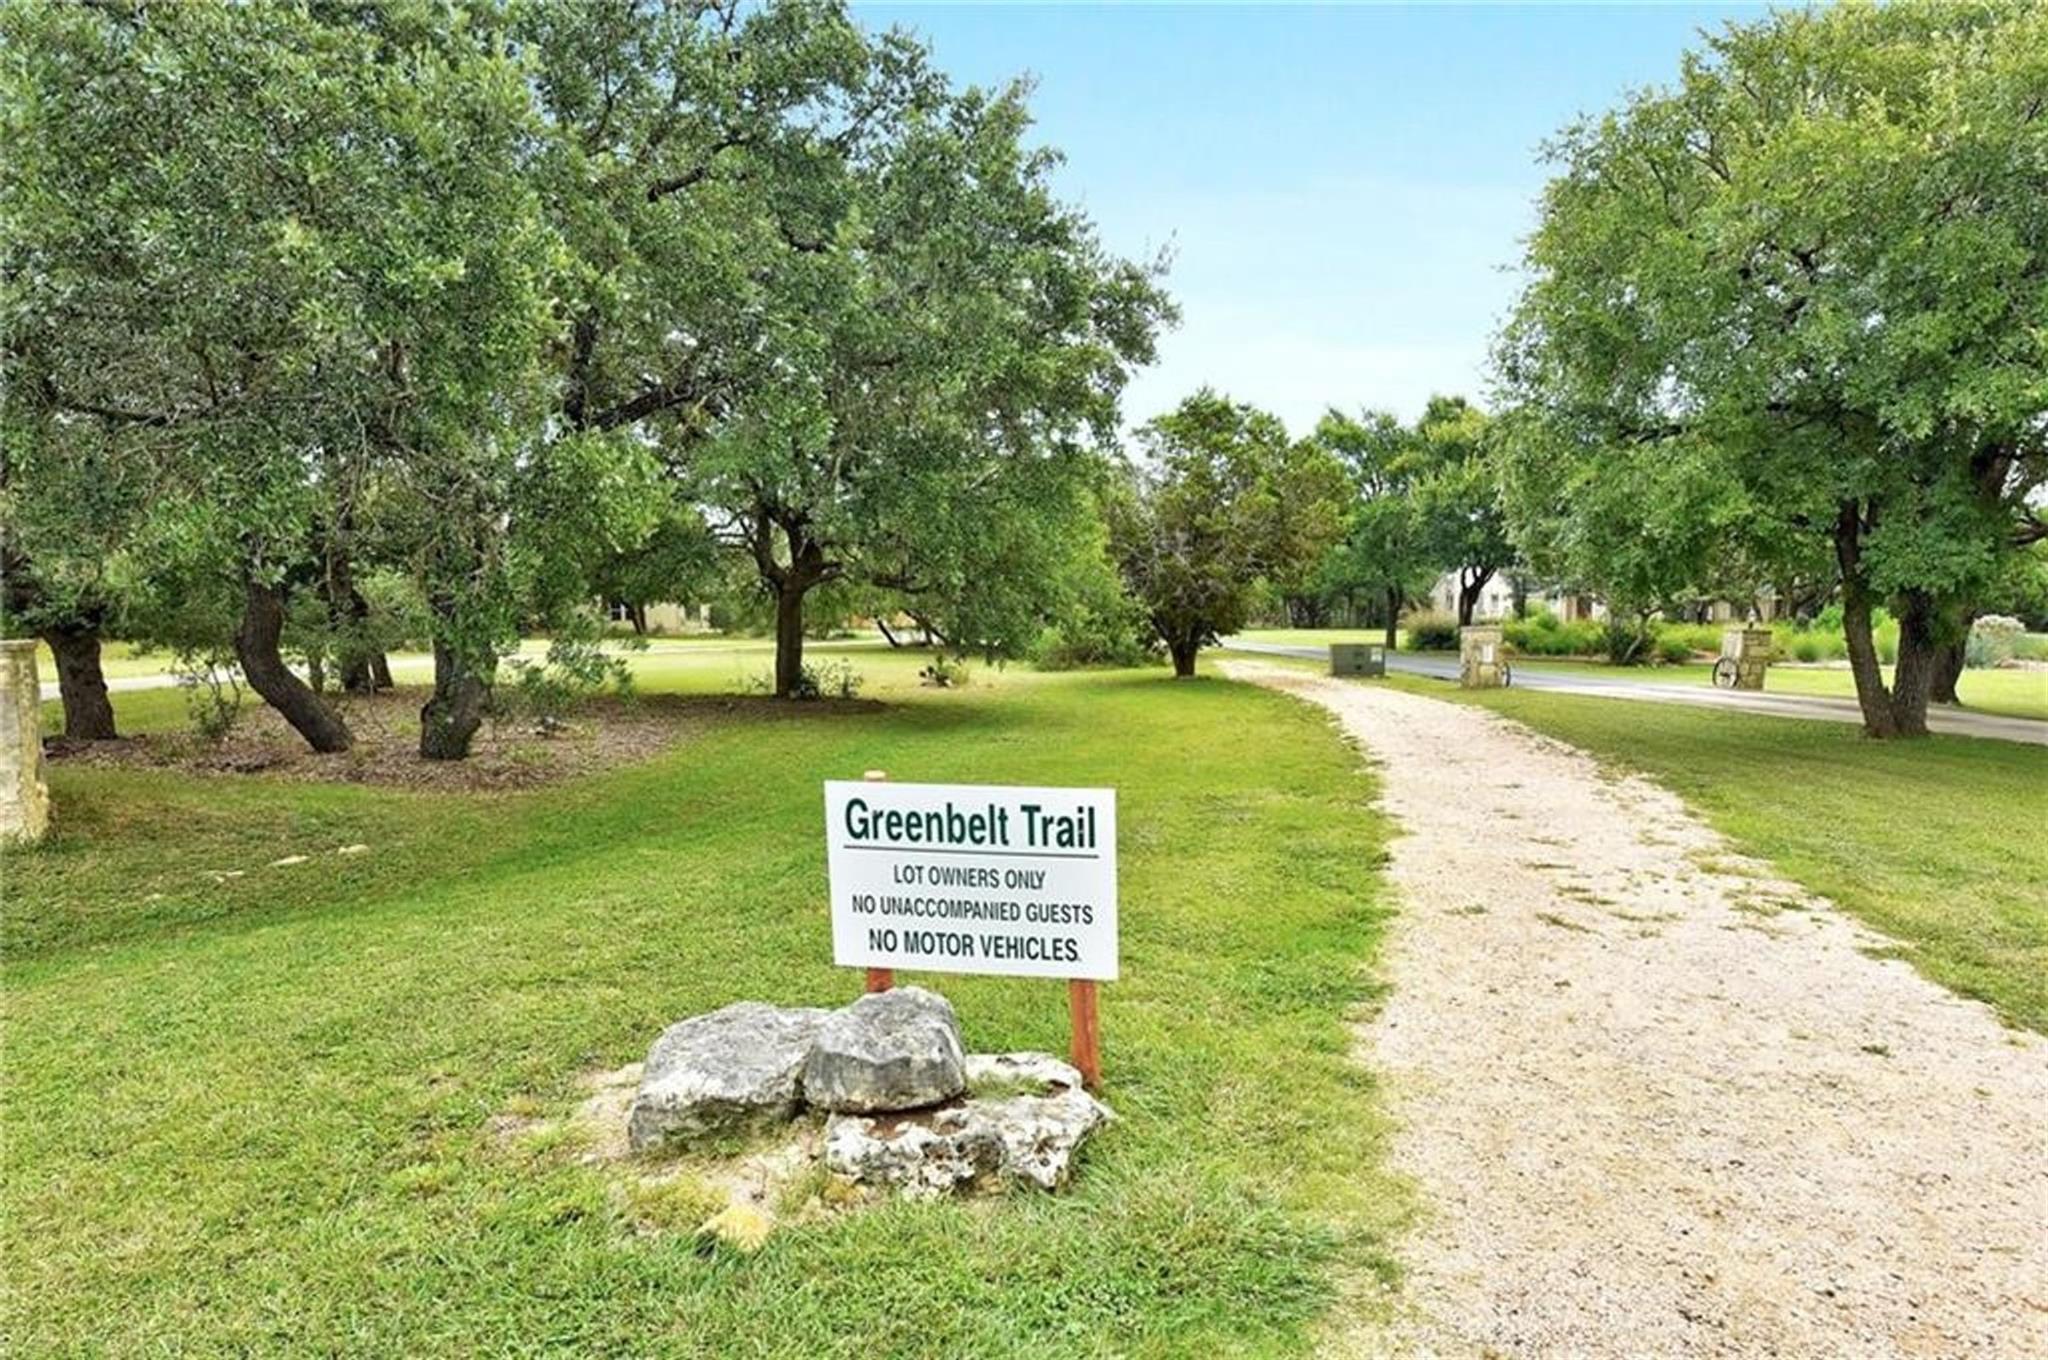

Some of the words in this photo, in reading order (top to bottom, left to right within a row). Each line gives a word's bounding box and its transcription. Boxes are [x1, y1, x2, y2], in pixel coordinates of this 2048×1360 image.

[845, 798, 1009, 846] Greenbelt
[1021, 805, 1096, 848] Trail
[894, 864, 924, 884] LOT
[928, 866, 1000, 888] OWNERS
[1004, 869, 1046, 889] ONLY
[852, 895, 876, 914] NO
[880, 897, 1020, 921] UNACCOMPANIED
[1026, 904, 1093, 924] GUESTS
[869, 929, 897, 951] NO
[904, 931, 975, 957] MOTOR
